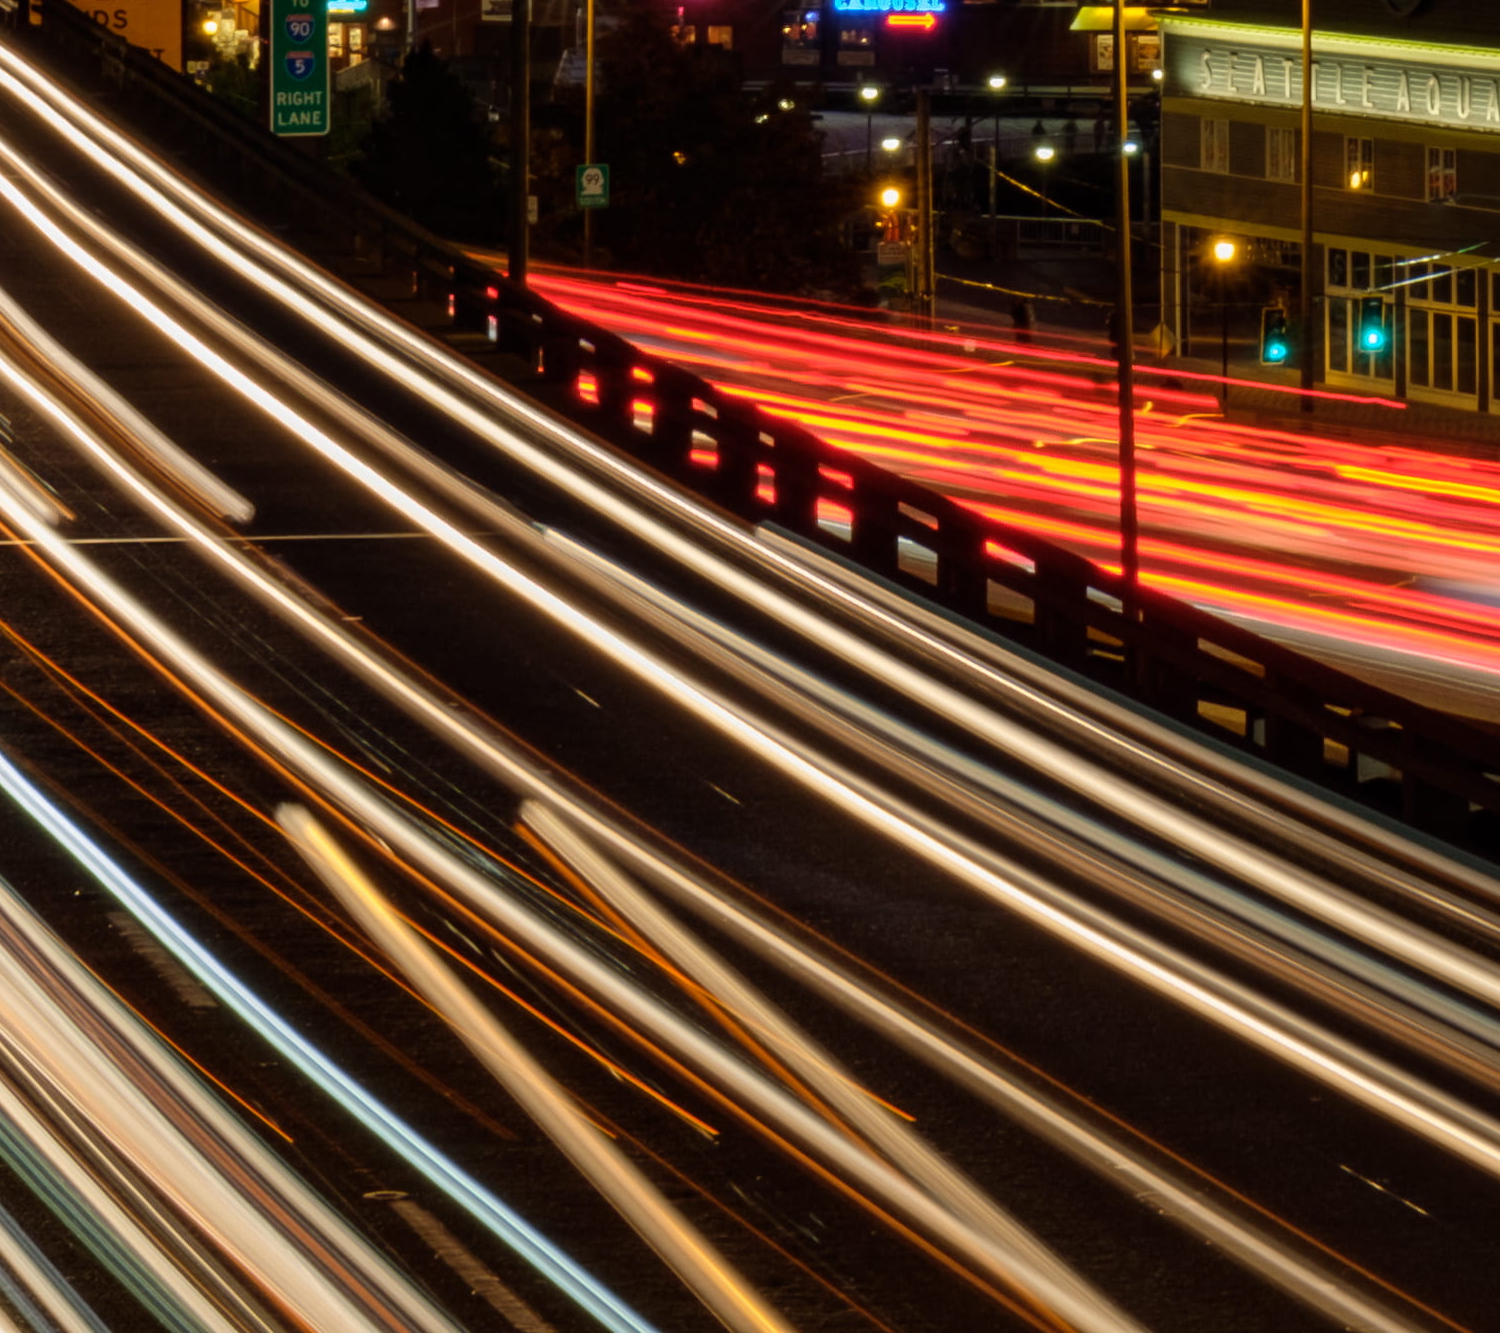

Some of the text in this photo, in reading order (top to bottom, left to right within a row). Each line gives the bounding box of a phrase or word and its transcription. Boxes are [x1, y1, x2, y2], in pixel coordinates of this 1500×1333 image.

[290, 21, 311, 37] 90
[294, 58, 306, 75] 5
[1201, 48, 1374, 108] SEATTLE
[276, 91, 324, 106] RIGHT
[277, 110, 323, 126] LANE
[585, 173, 600, 185] 99
